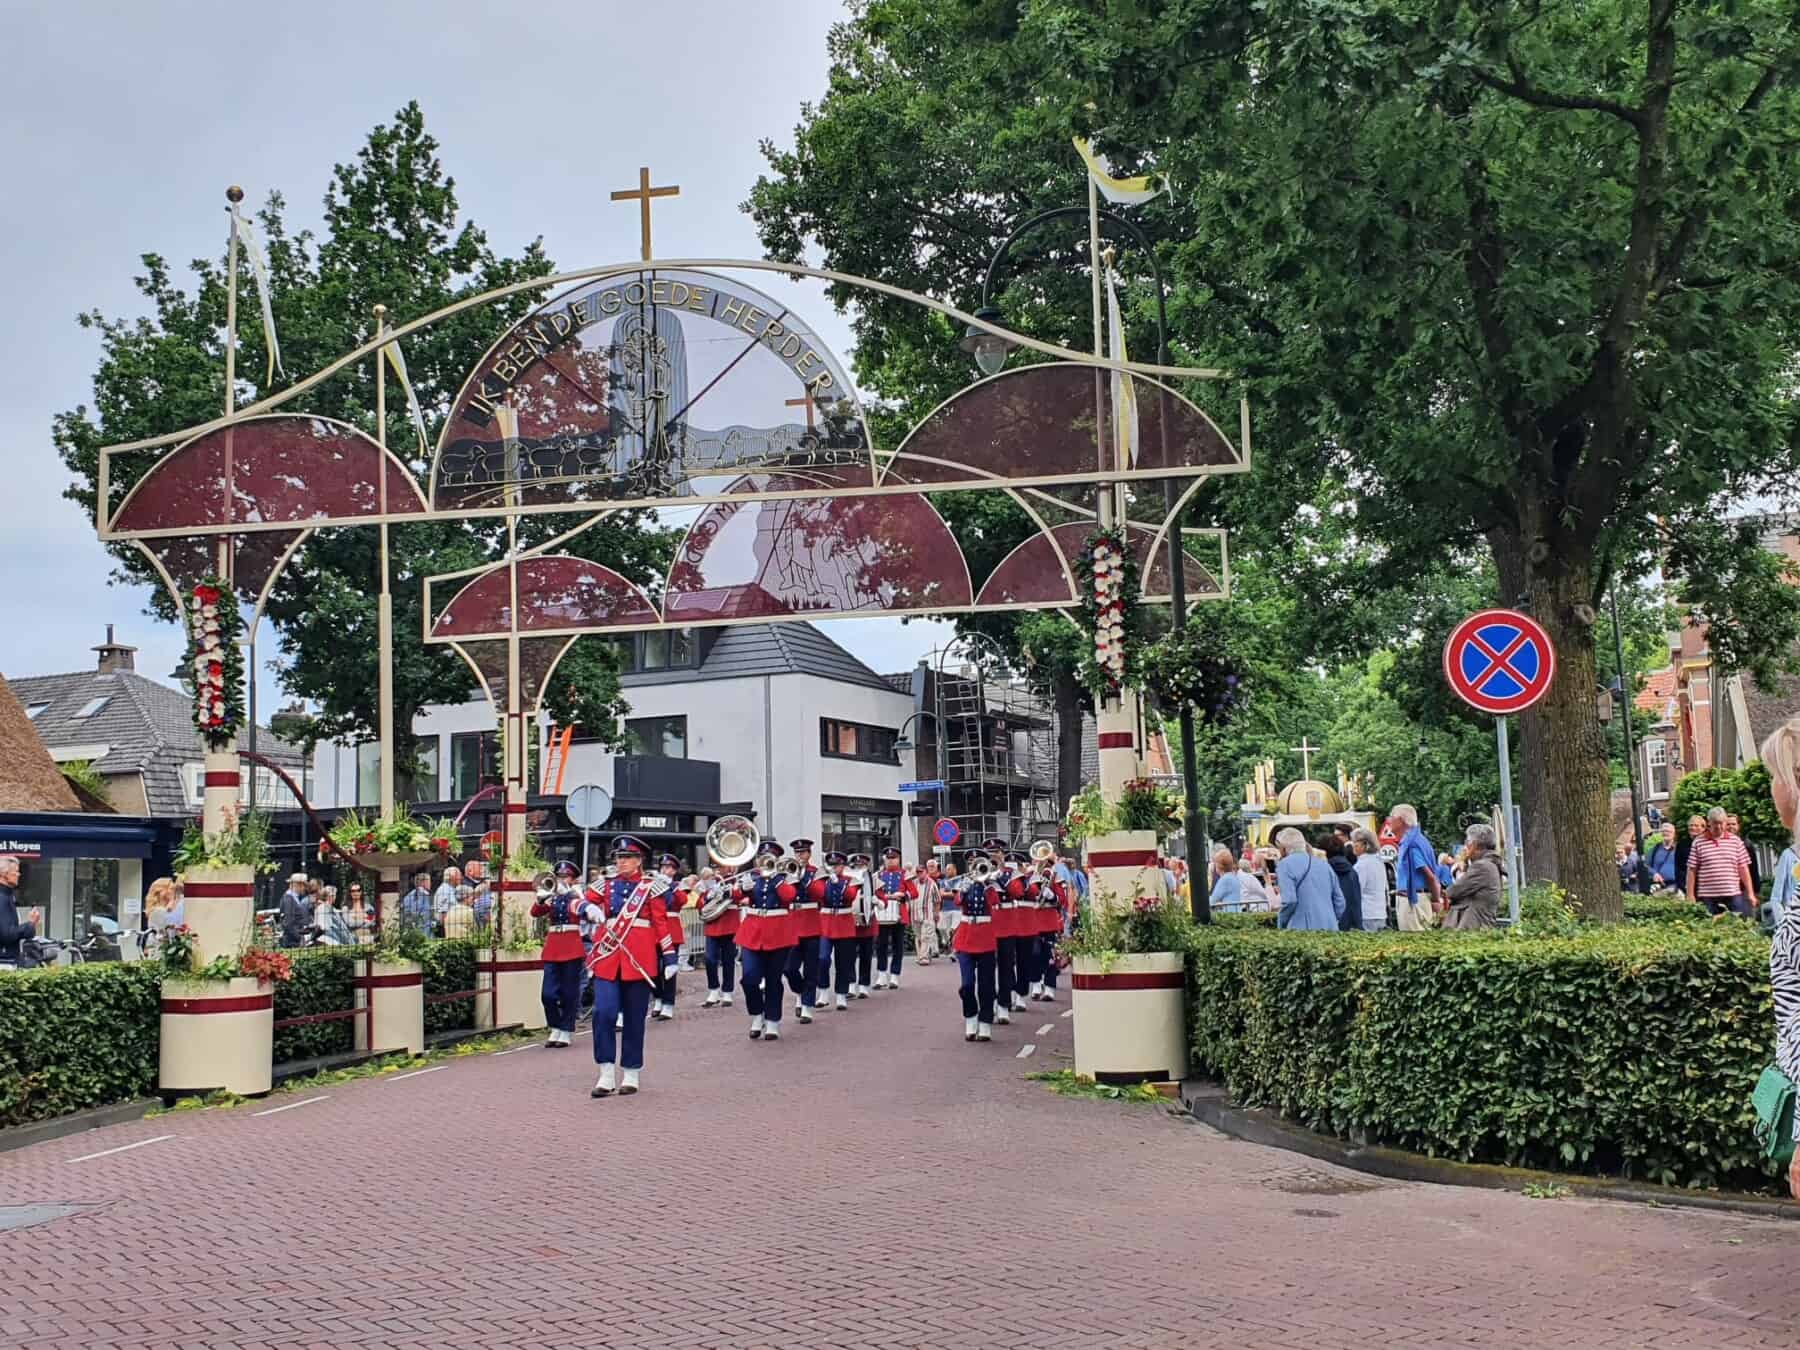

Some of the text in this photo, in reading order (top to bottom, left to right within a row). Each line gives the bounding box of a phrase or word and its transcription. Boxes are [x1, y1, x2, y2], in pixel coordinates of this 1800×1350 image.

[469, 280, 833, 415] IK BEN DE GOEDE HERDER
